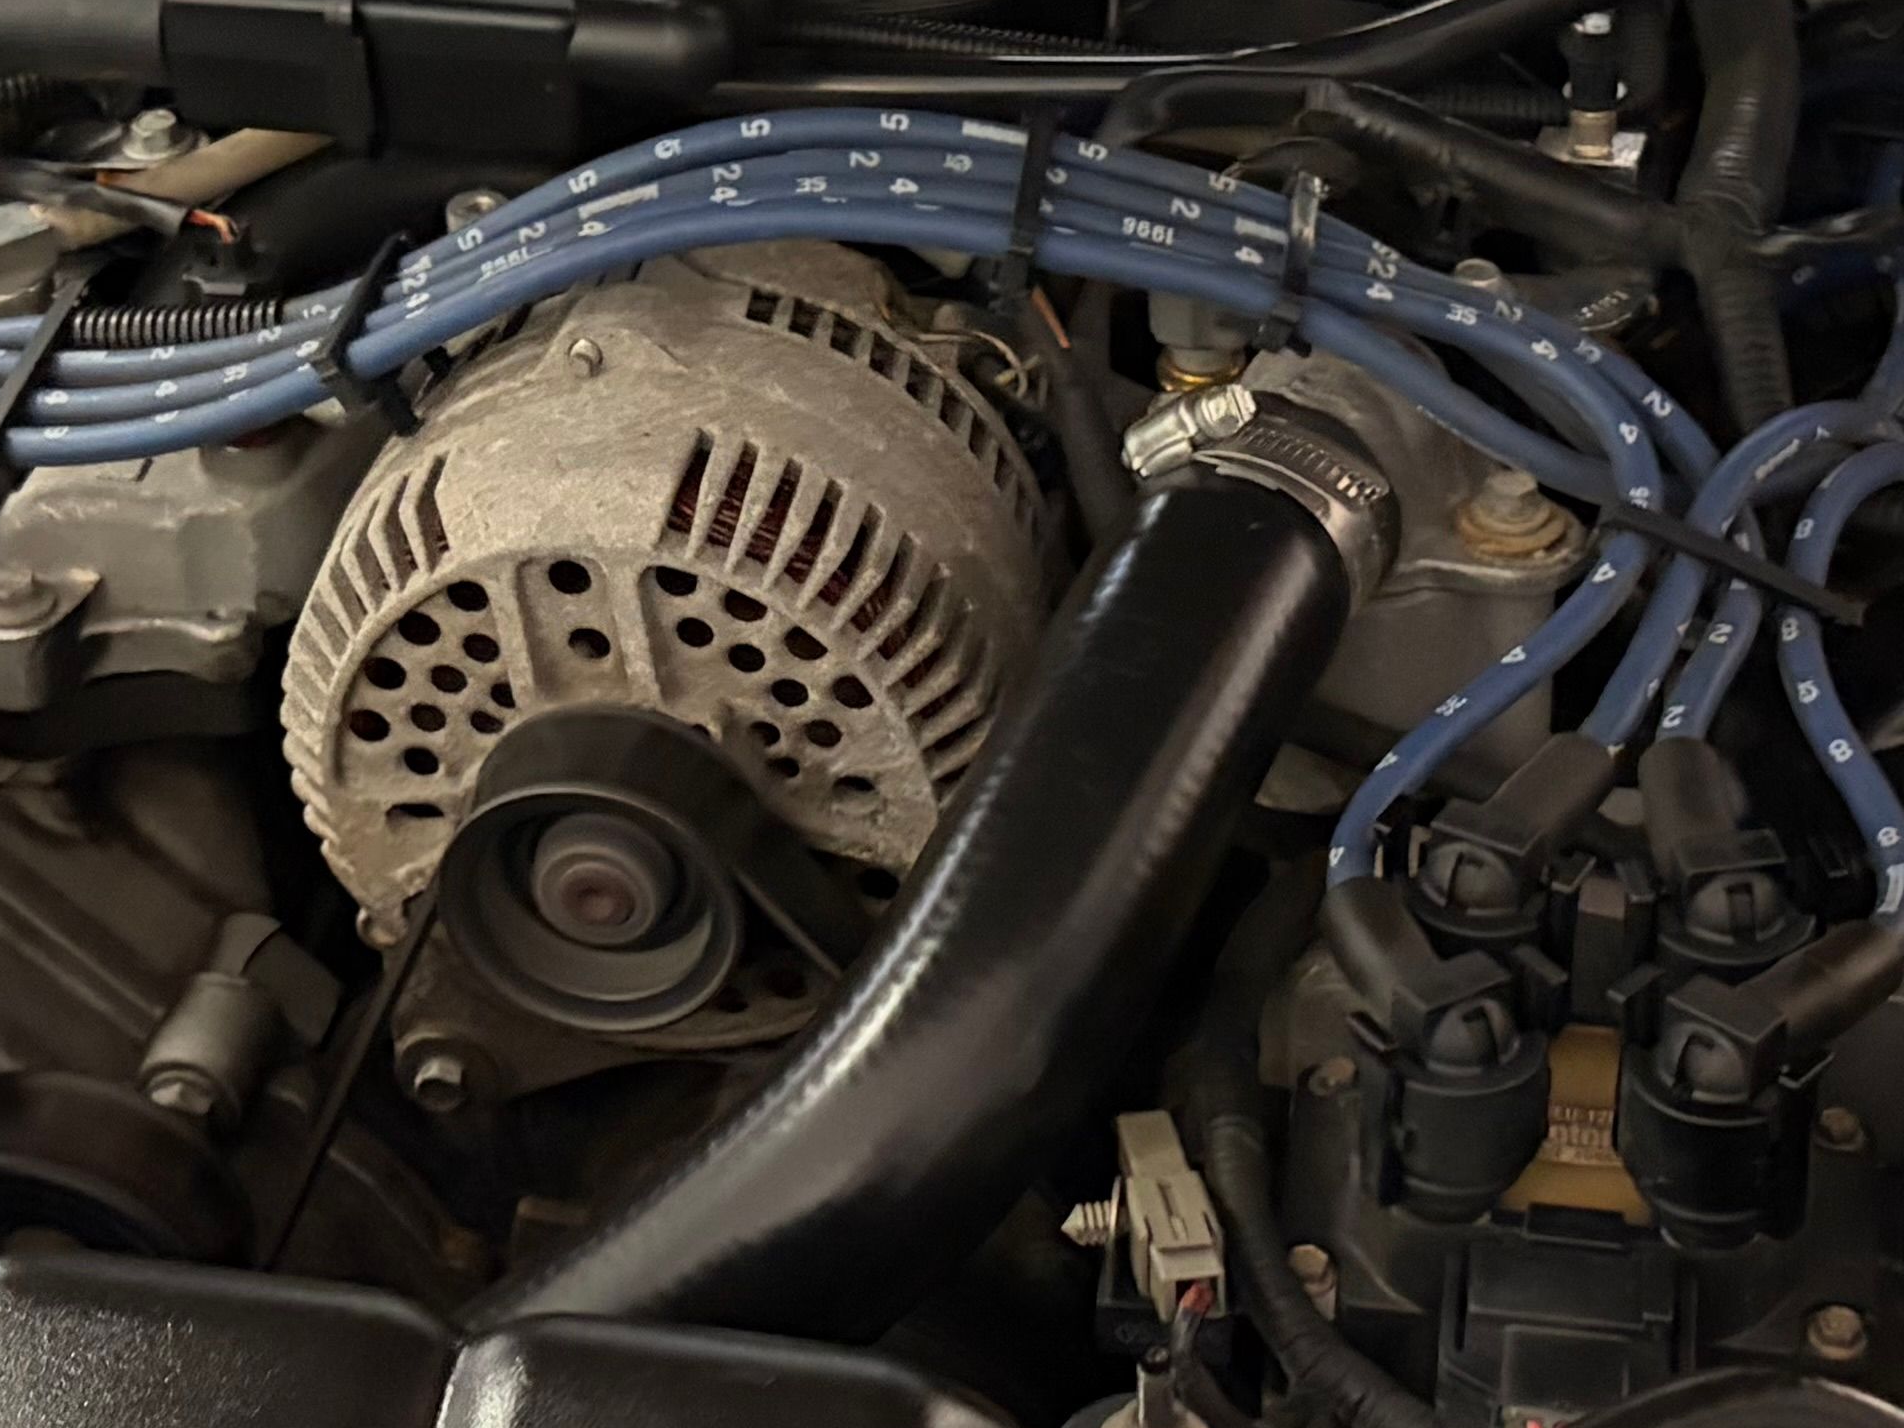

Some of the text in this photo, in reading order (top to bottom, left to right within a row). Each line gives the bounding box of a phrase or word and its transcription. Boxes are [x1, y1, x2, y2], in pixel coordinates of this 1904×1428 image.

[741, 118, 771, 140] 5
[880, 113, 909, 131] 5
[850, 150, 880, 169] 2
[1077, 142, 1108, 161] 5
[569, 170, 597, 193] 5
[712, 164, 743, 183] 2
[1171, 197, 1200, 219] 2
[457, 228, 484, 252] 5
[517, 221, 546, 245] 2
[1366, 284, 1393, 301] 4
[1643, 390, 1672, 417] 2
[1829, 739, 1853, 763] 8
